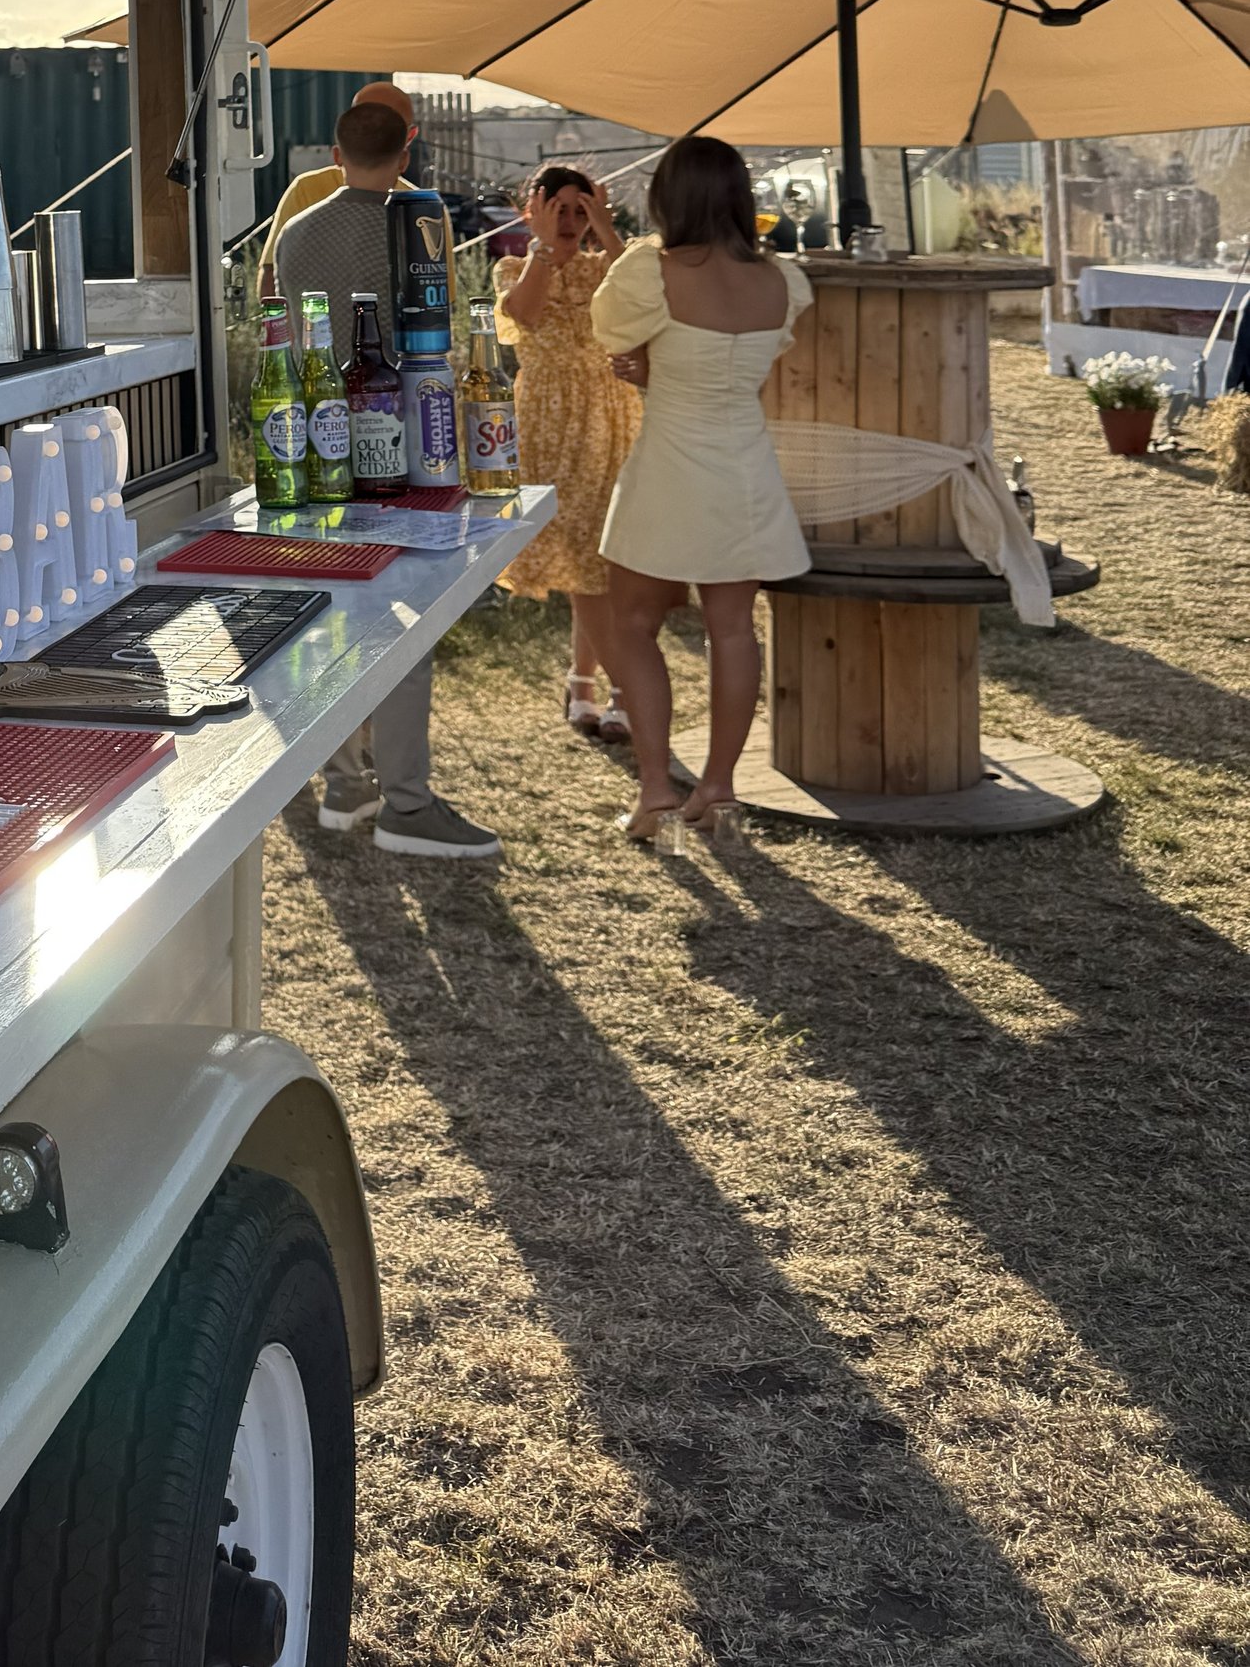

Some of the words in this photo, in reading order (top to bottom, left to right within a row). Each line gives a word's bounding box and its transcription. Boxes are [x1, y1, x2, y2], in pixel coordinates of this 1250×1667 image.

[430, 397, 445, 458] ARTOIS
[442, 397, 454, 454] STELLA
[356, 439, 386, 451] OLD
[358, 448, 401, 462] MOUT
[358, 461, 401, 475] CIDER
